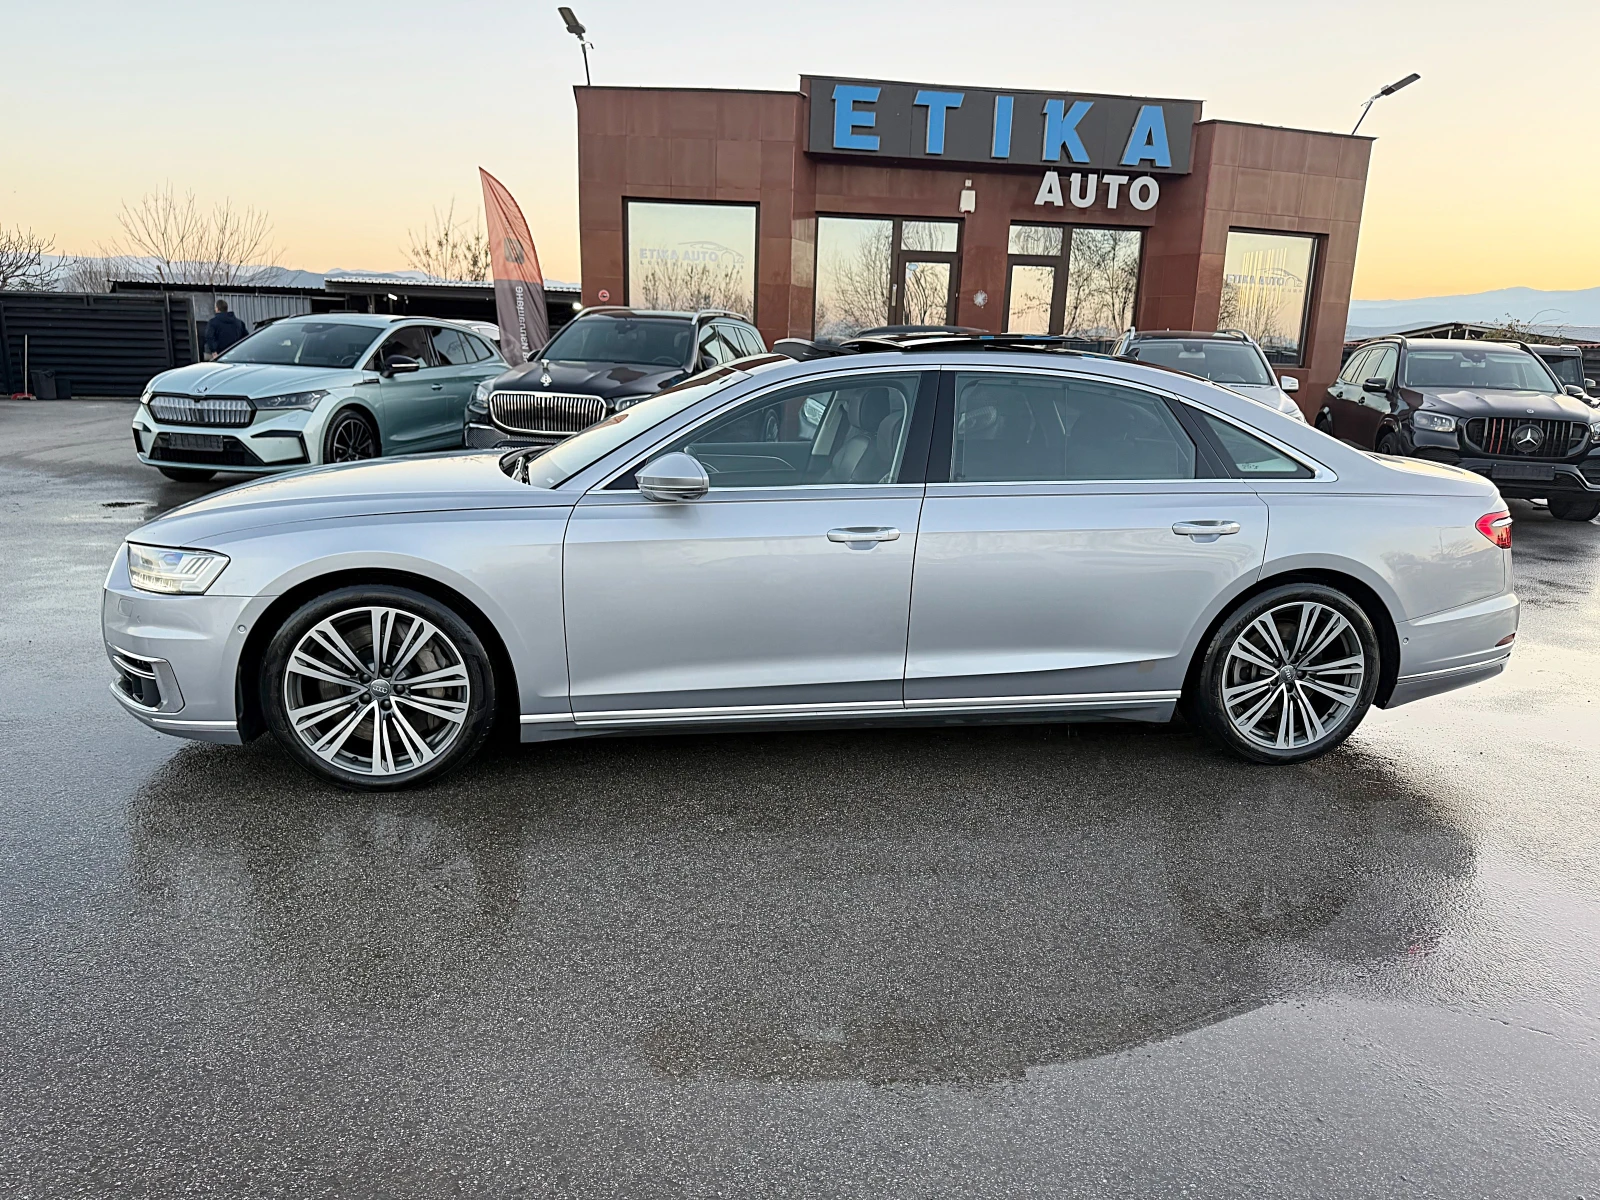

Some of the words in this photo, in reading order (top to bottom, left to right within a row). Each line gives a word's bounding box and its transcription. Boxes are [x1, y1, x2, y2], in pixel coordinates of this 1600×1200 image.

[831, 84, 1172, 168] ETIKA
[1033, 171, 1160, 212] AUTO
[639, 248, 678, 260] ETIKA
[682, 250, 719, 262] AUTO
[1226, 274, 1256, 285] ETIKA
[1259, 275, 1285, 286] AUTO
